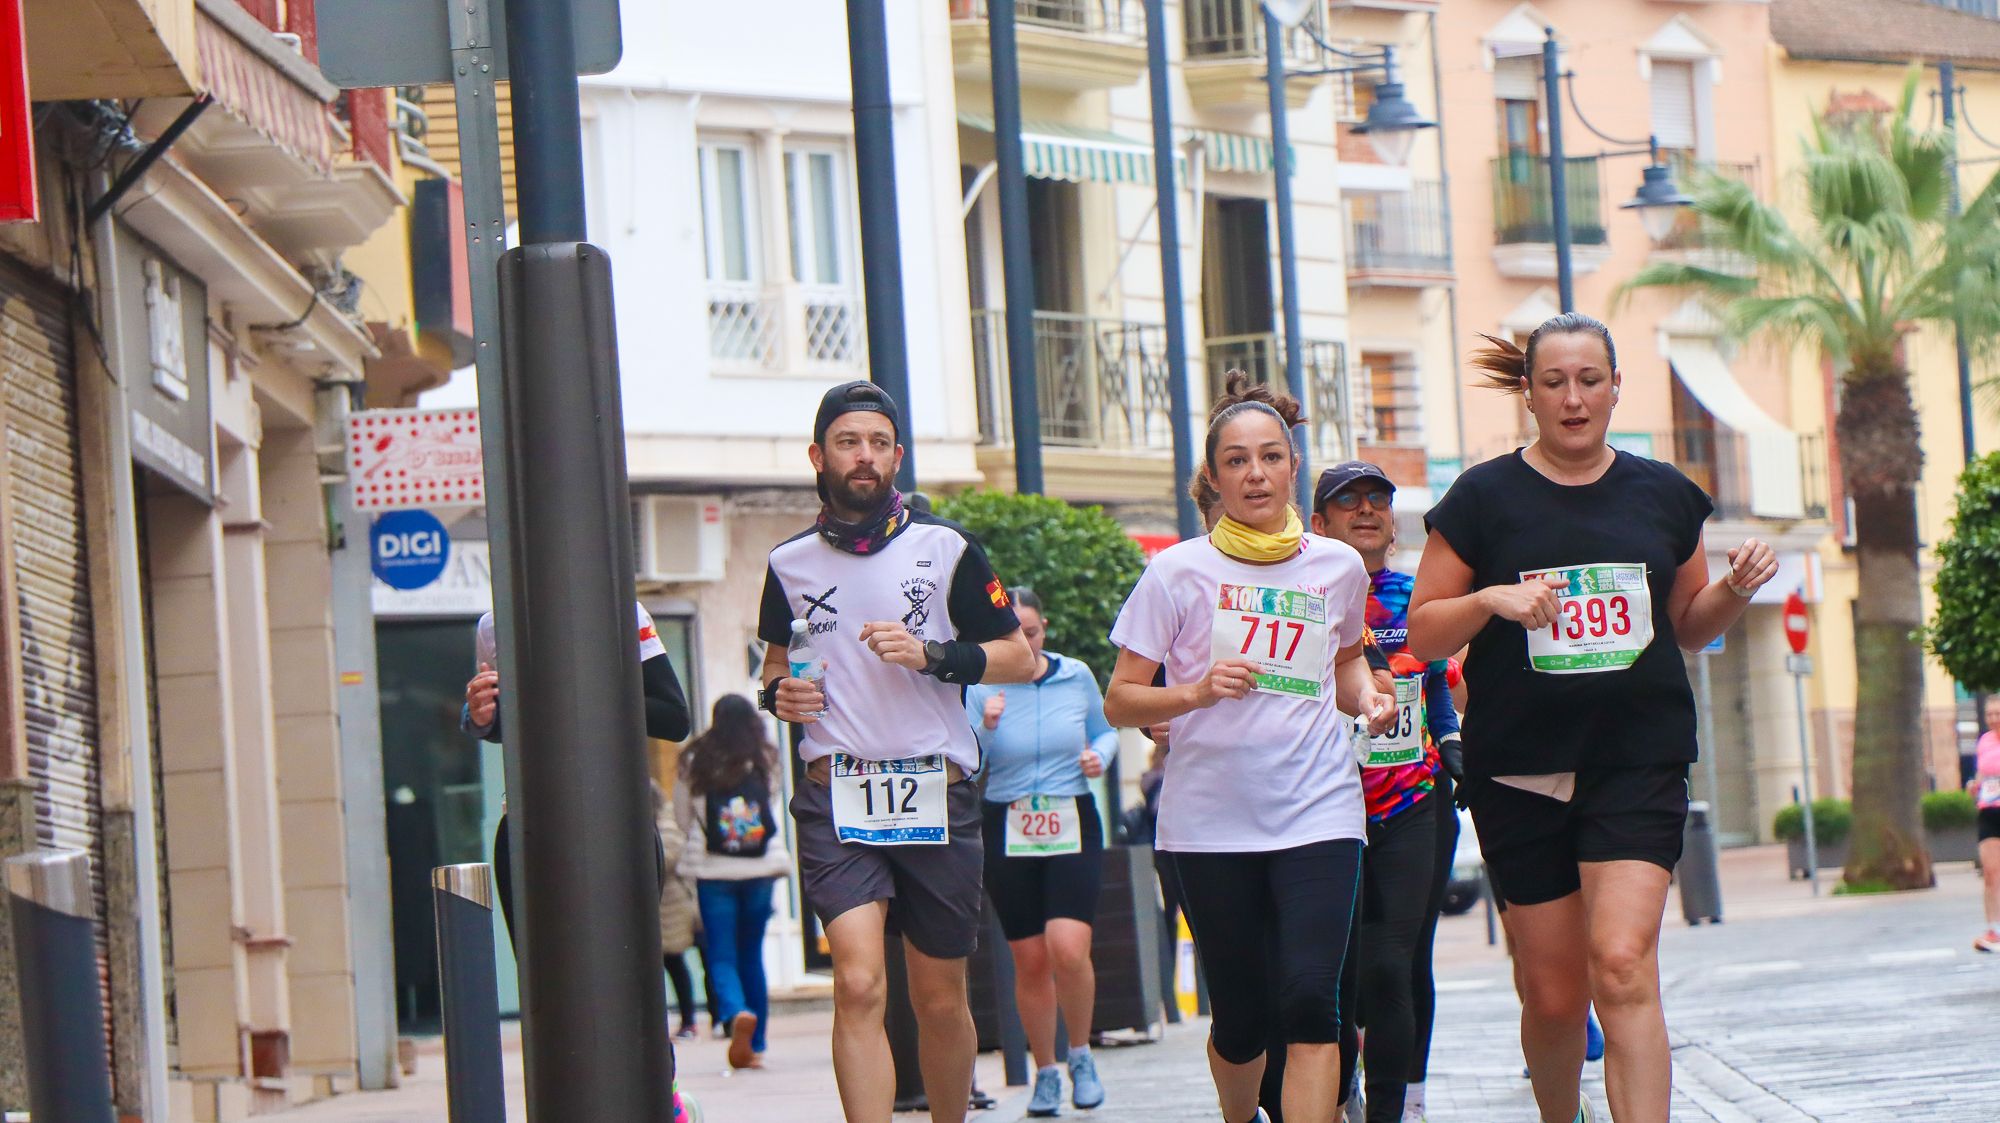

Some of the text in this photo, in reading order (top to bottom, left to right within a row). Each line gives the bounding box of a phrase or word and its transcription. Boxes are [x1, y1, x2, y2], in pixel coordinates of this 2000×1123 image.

[378, 531, 441, 558] DIGI
[1227, 587, 1264, 614] 10K
[1240, 615, 1304, 661] 717
[859, 777, 918, 815] 112
[1022, 812, 1060, 836] 226
